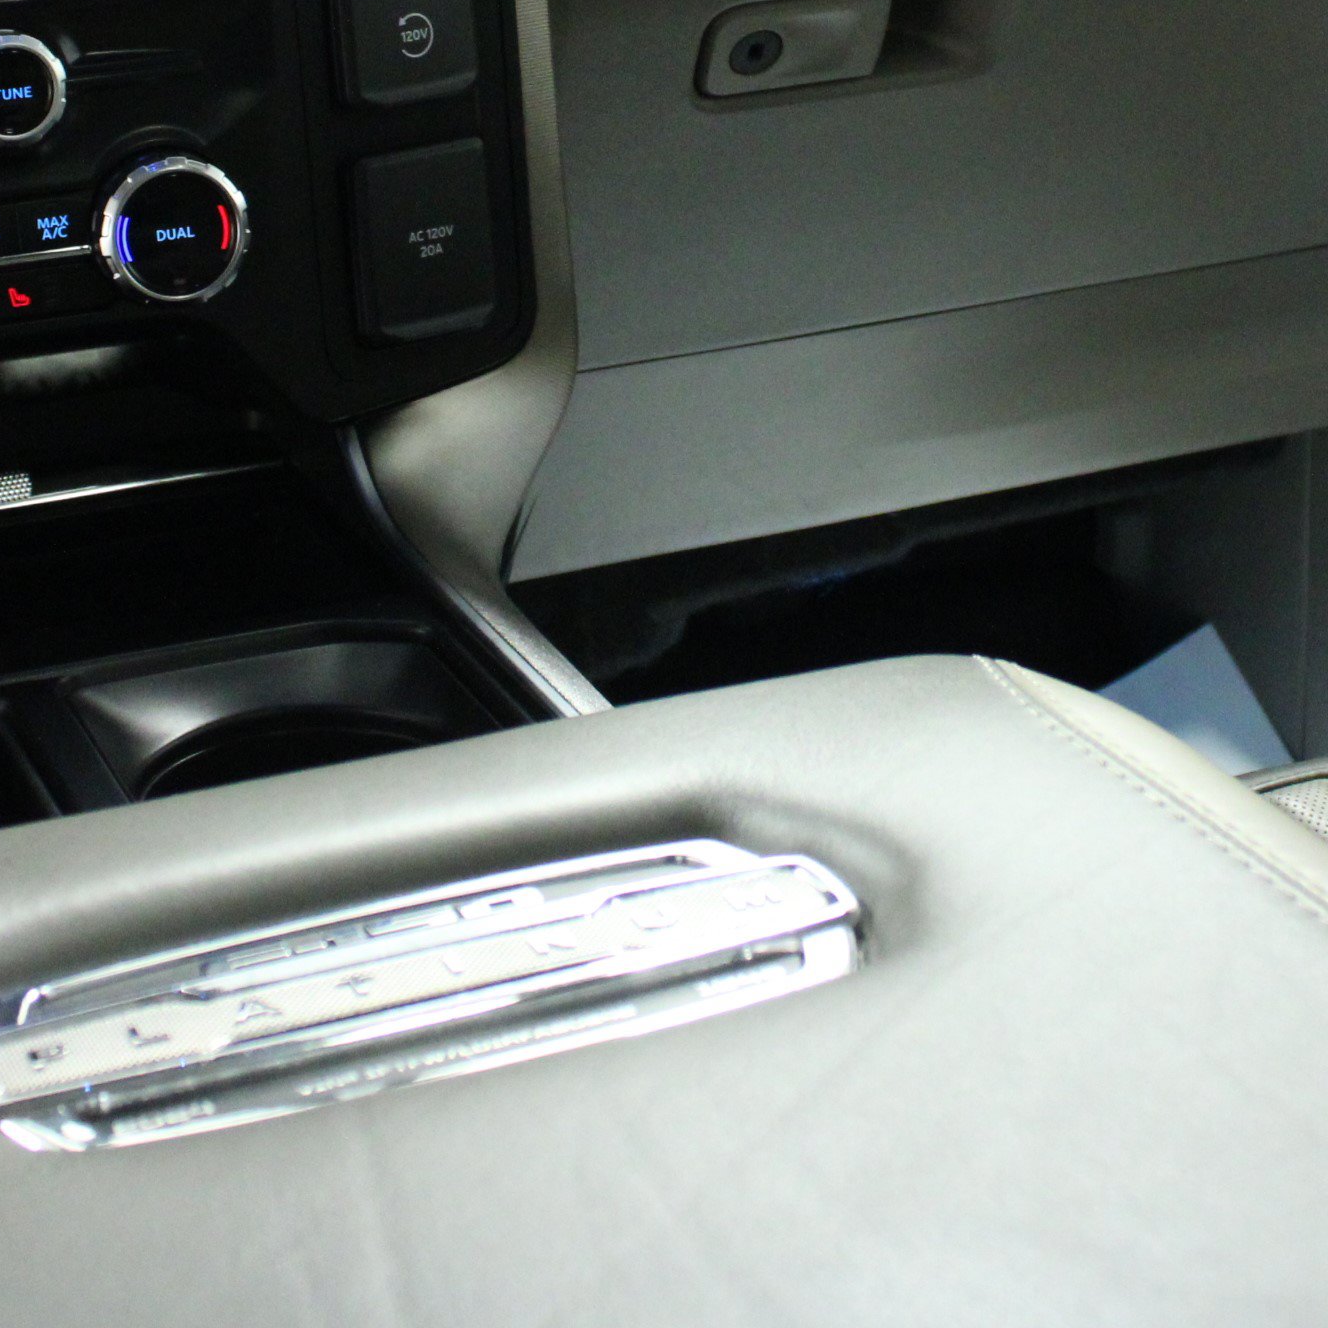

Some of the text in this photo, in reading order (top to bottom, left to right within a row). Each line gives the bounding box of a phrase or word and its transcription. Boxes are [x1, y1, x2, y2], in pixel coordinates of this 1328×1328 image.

[399, 26, 430, 44] 120V
[36, 214, 70, 230] MAX
[41, 225, 69, 241] A/C
[155, 226, 196, 243] DUAL
[408, 224, 456, 244] AC 120V
[419, 242, 445, 259] 20A
[26, 882, 784, 1071] PLATINUM
